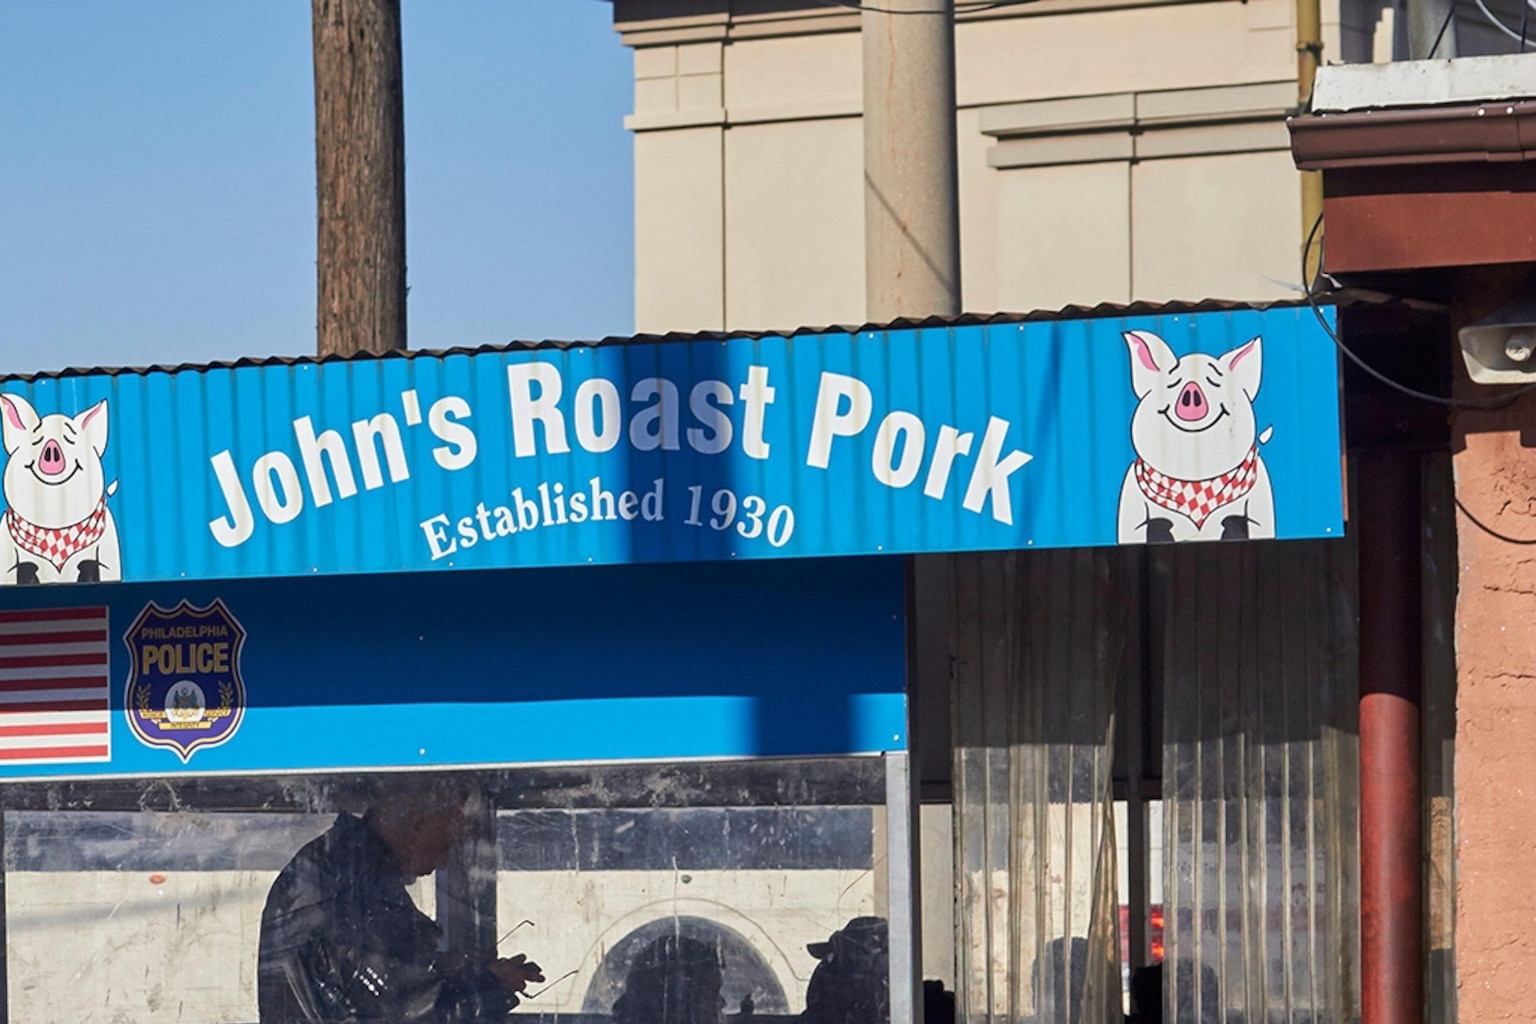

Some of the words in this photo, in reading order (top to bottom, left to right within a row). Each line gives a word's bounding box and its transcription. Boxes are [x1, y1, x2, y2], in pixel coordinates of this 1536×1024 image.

[209, 389, 479, 548] John's
[507, 361, 776, 460] Roast
[806, 371, 1034, 526] Pork
[420, 477, 664, 561] Established
[683, 485, 795, 548] 1930
[141, 625, 229, 640] PHILADELPHIA
[142, 642, 229, 676] POLICE
